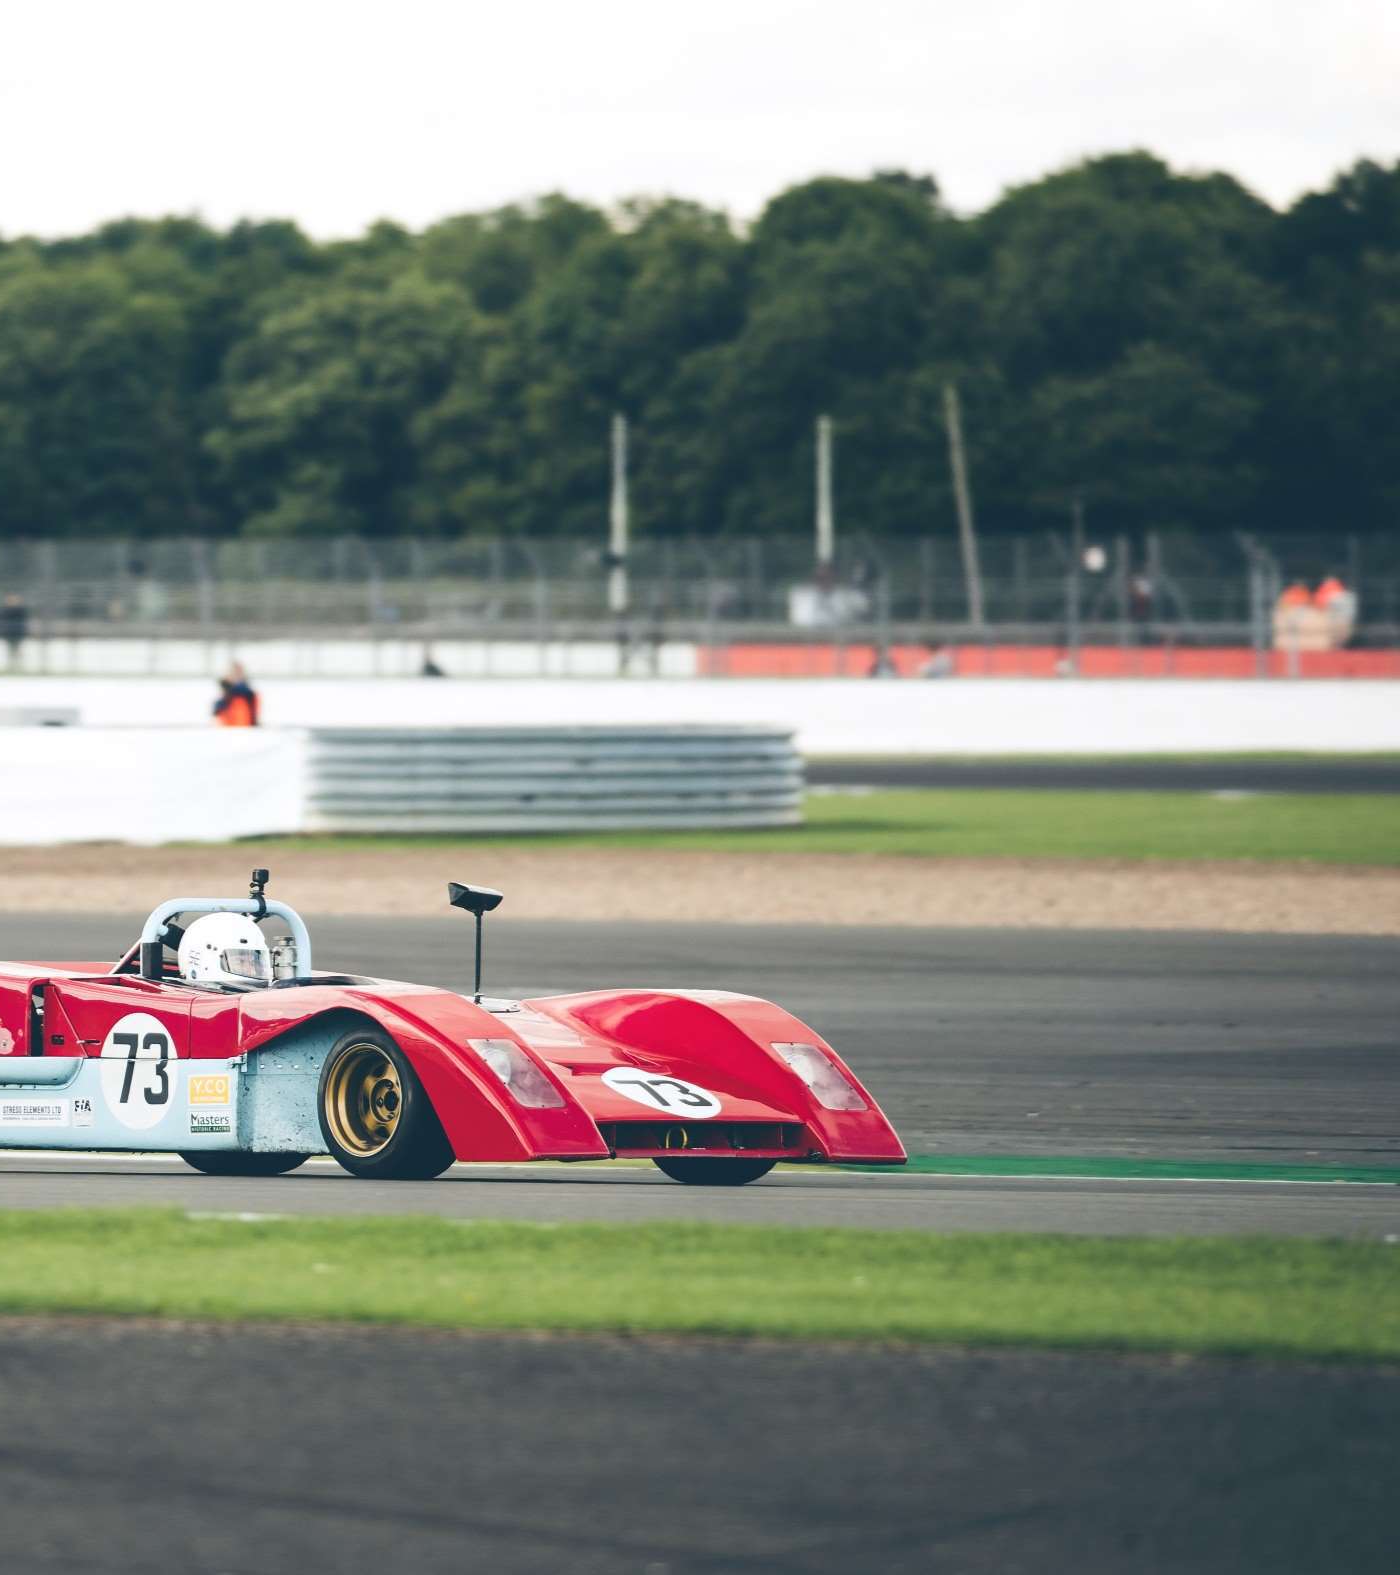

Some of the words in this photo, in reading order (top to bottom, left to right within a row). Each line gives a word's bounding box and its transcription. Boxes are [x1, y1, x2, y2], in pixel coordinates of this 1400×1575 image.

[113, 1032, 169, 1105] 73
[611, 1079, 713, 1107] 73
[23, 1105, 50, 1114] ELEMENTS
[51, 1105, 62, 1114] LTD
[190, 1113, 230, 1125] Masters
